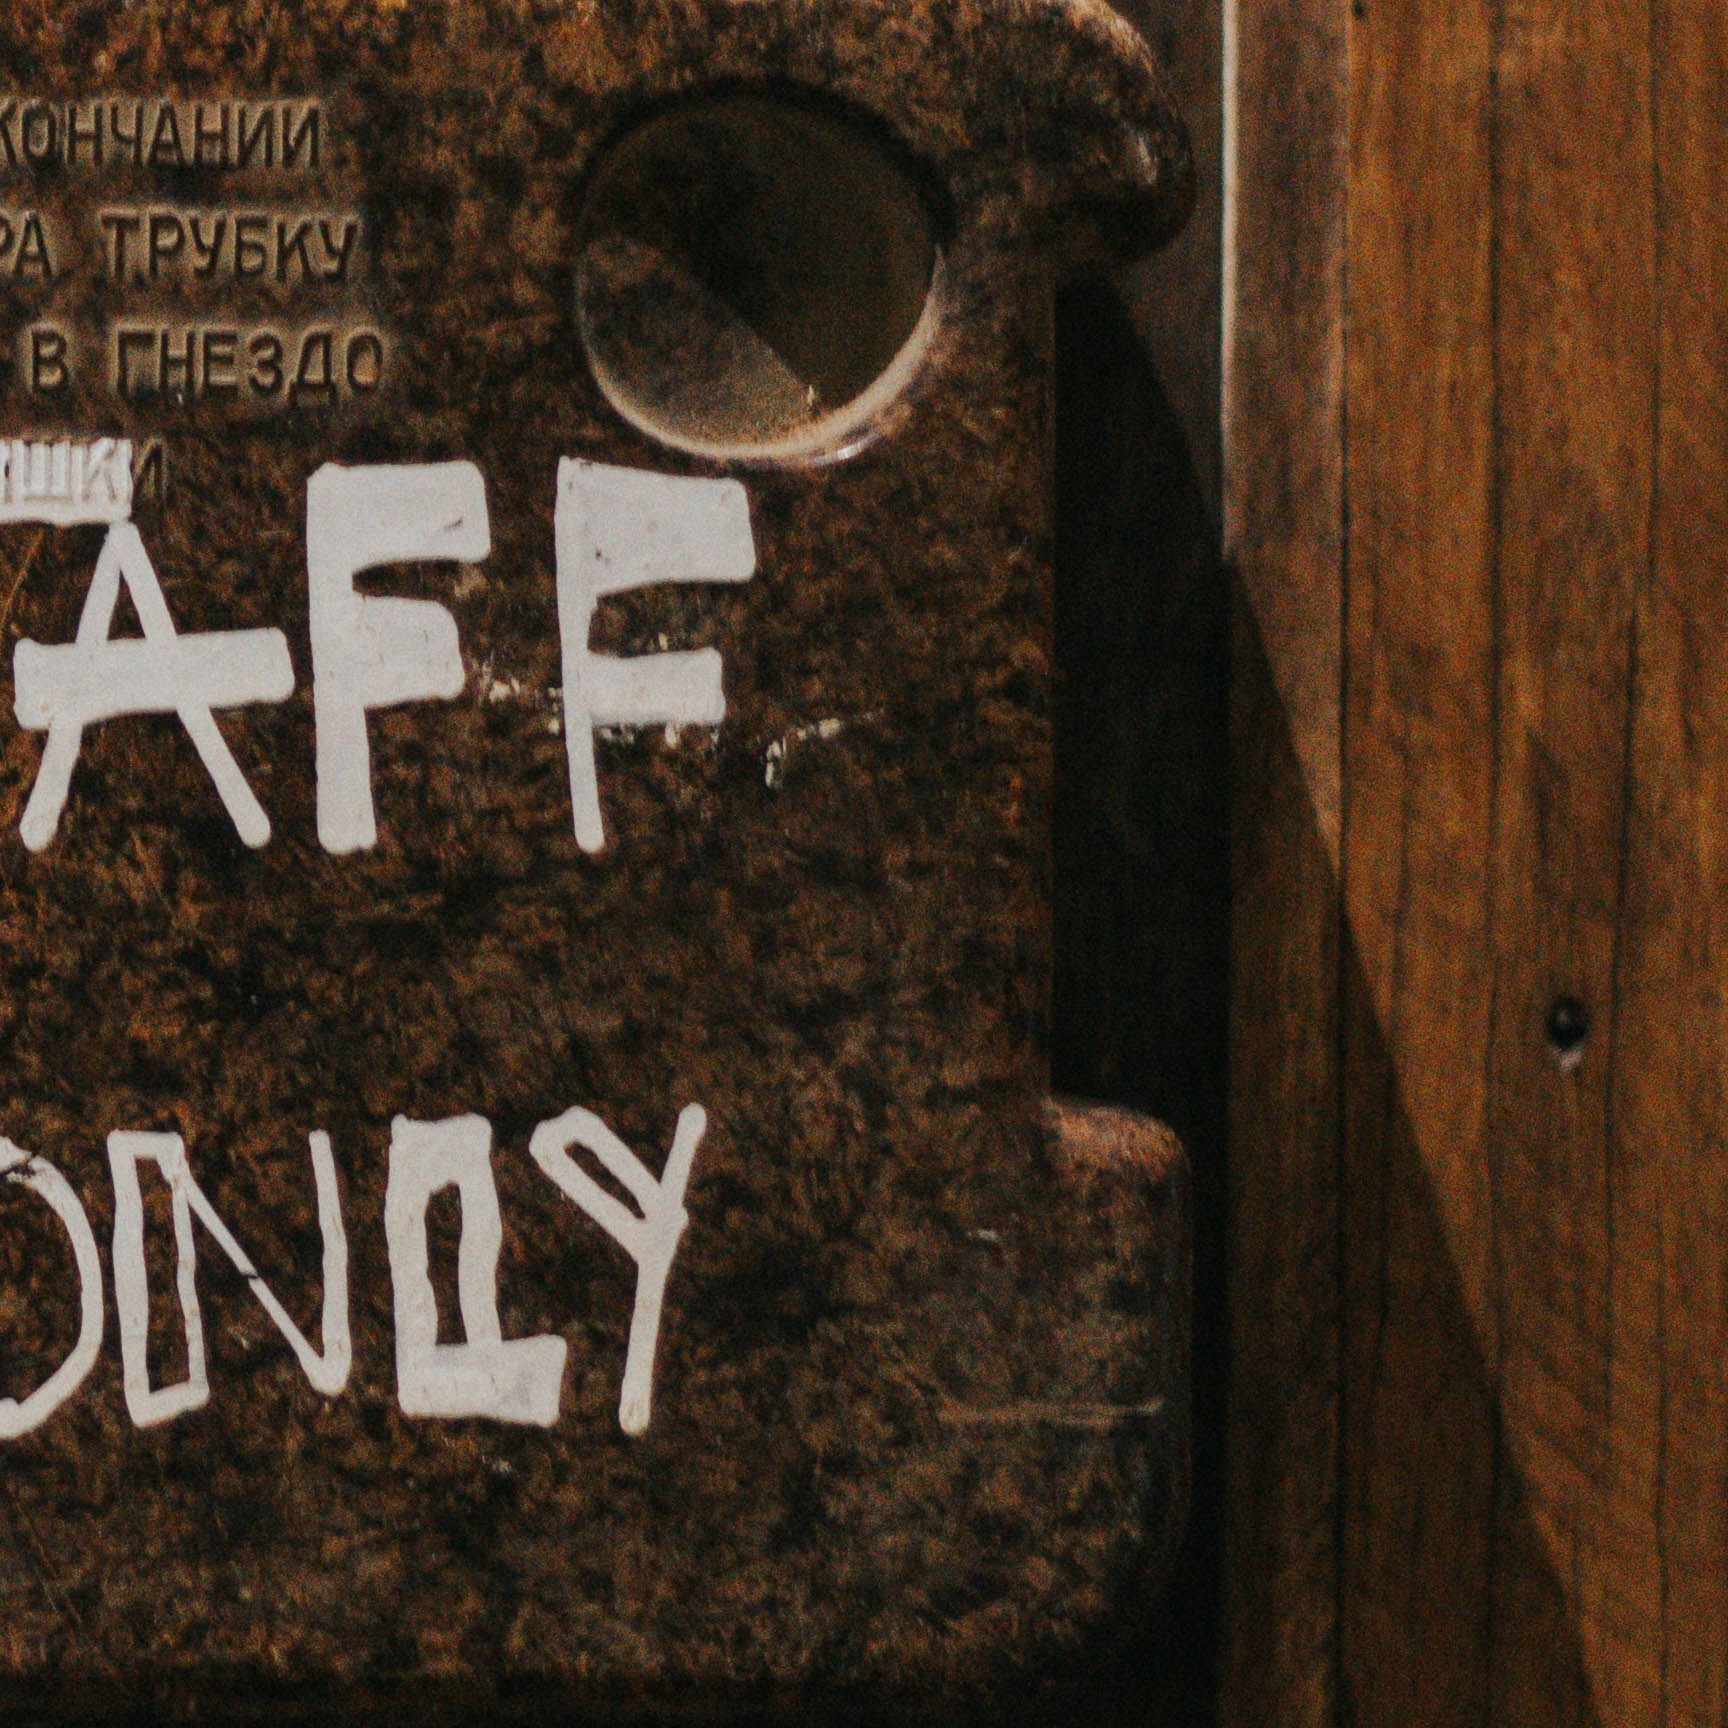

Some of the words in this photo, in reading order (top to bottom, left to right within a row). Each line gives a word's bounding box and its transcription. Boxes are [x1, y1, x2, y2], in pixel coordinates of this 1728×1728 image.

[99, 208, 362, 279] ТРУБКУ
[30, 322, 72, 394] В
[113, 320, 385, 408] ГНЕЗДО
